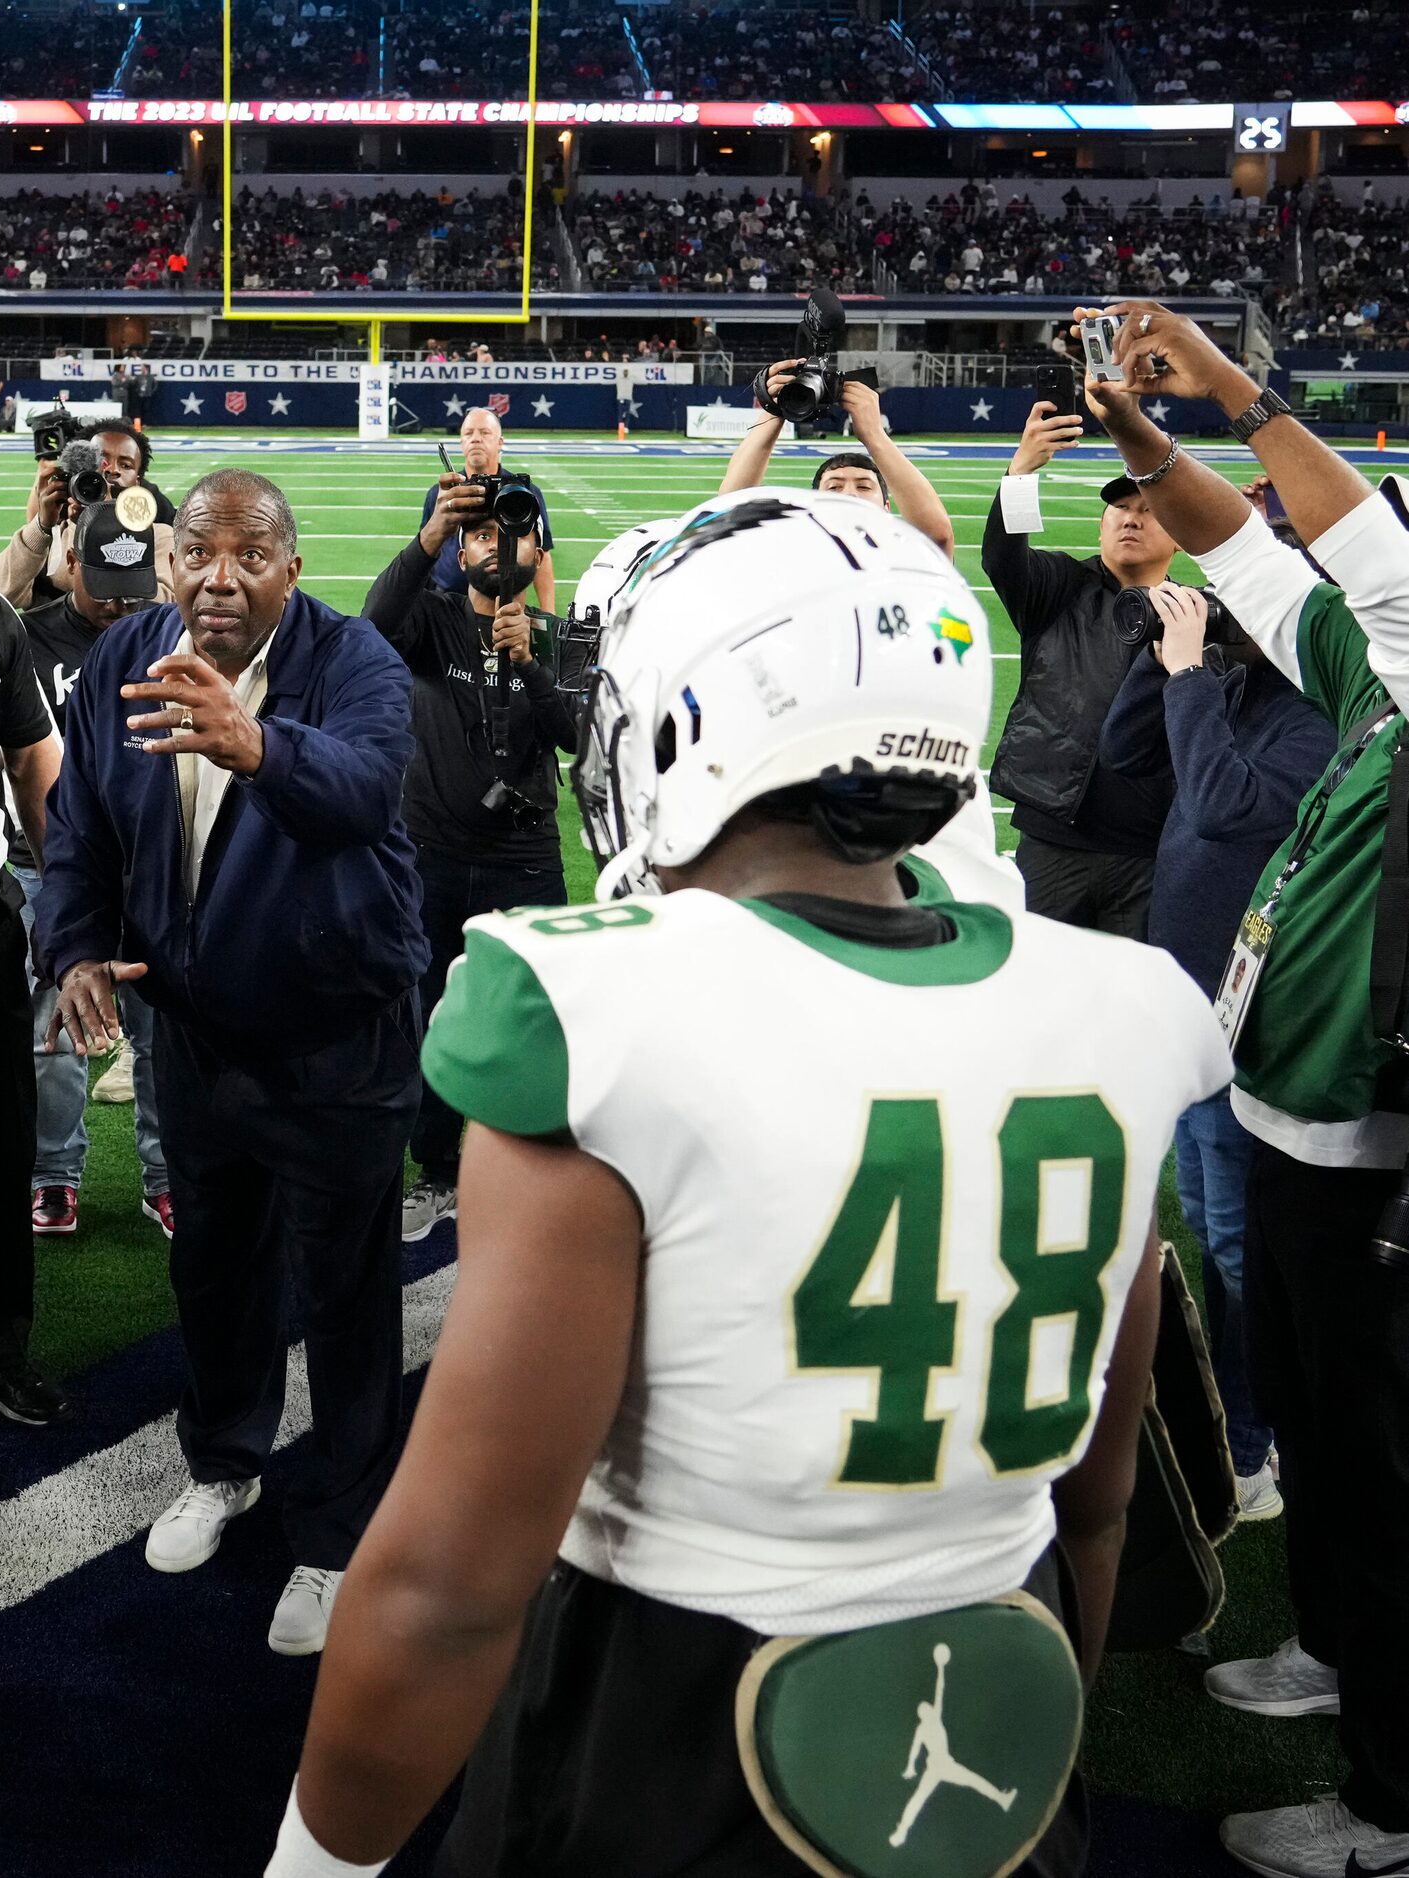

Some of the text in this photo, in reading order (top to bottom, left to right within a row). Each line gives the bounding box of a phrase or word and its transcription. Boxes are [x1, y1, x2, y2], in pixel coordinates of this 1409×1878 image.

[87, 101, 700, 124] THE 2023 UIL FOOTBALL STATE CHAMPIONSHIPS
[1239, 117, 1282, 149] 25
[107, 363, 236, 379] WECOME
[247, 365, 279, 379] TO
[289, 365, 338, 380] THE
[389, 364, 617, 381] HAMPIONSHIPS
[877, 604, 910, 640] 48
[503, 904, 655, 936] 8
[1244, 910, 1273, 946] EAGLES
[783, 1085, 1131, 1492] 48
